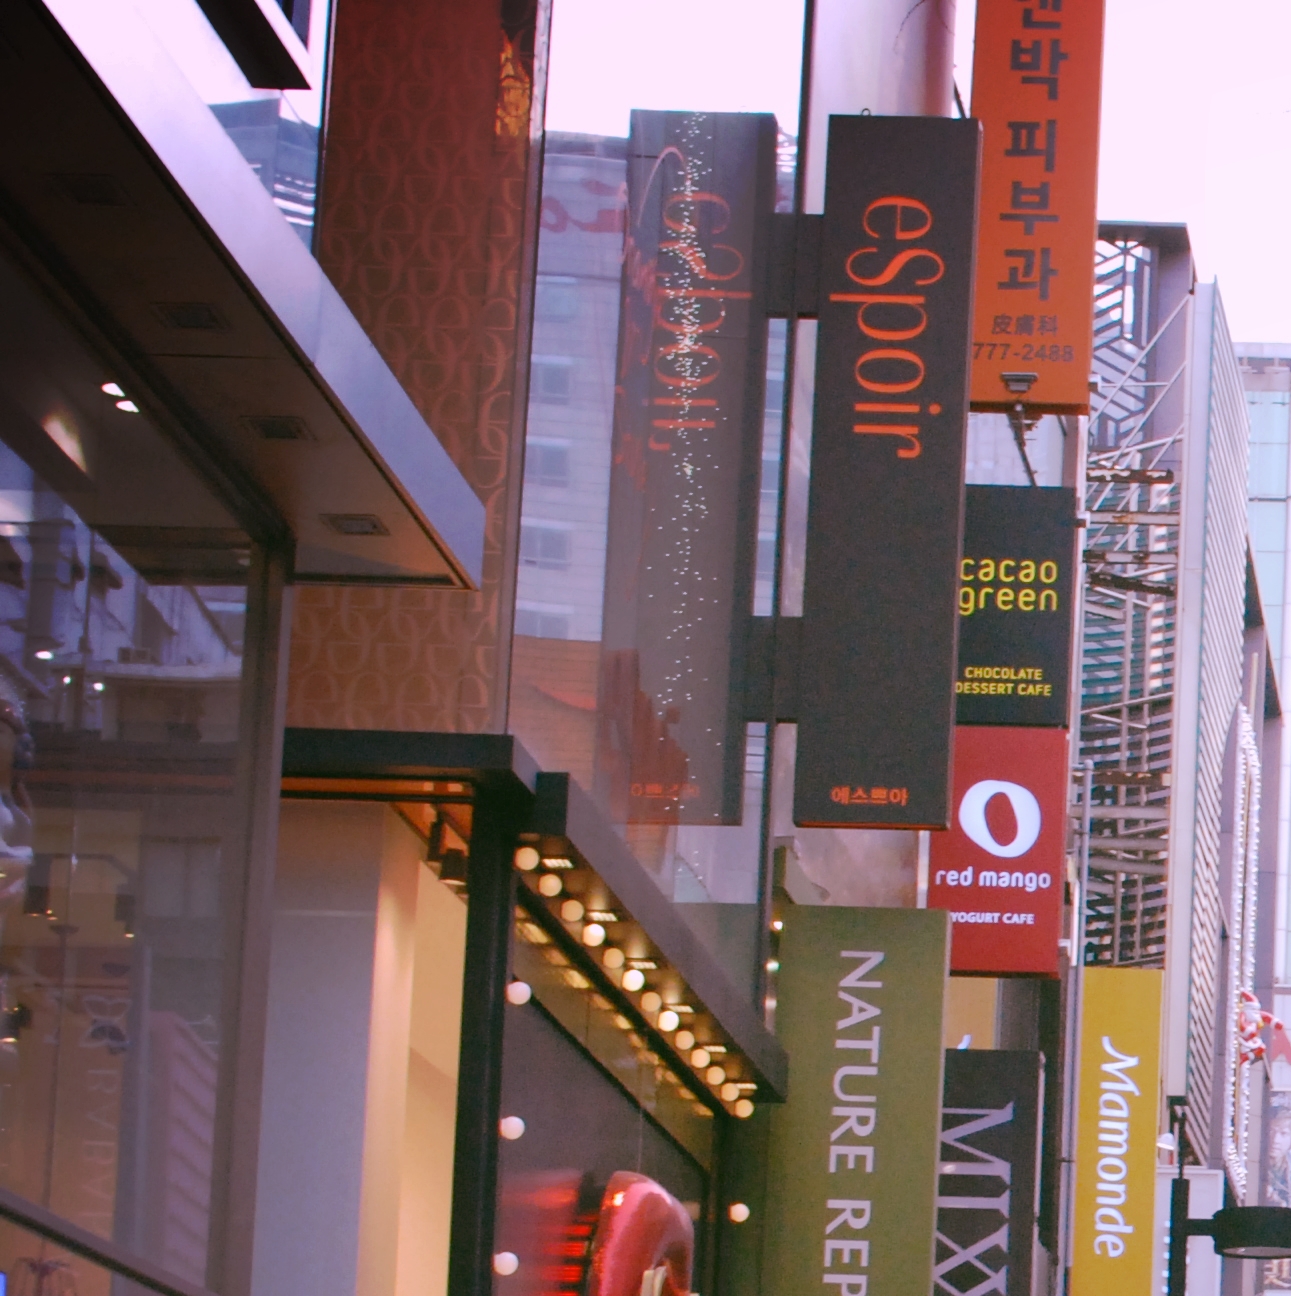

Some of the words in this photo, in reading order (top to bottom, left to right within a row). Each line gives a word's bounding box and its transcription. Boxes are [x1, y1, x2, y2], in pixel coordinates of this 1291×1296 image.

[829, 195, 945, 460] espoir
[958, 558, 1058, 584] cacao
[956, 586, 1058, 616] green
[964, 666, 1043, 681] CHOCOLATE
[955, 681, 1014, 695] DESSERT
[1017, 682, 1052, 696] CAFE
[935, 866, 973, 889] red
[979, 867, 1052, 893] mango
[950, 911, 1000, 925] YOGURT
[1002, 911, 1035, 925] CAFE
[827, 949, 885, 1175] NATURE
[1093, 1035, 1141, 1259] Mamonde
